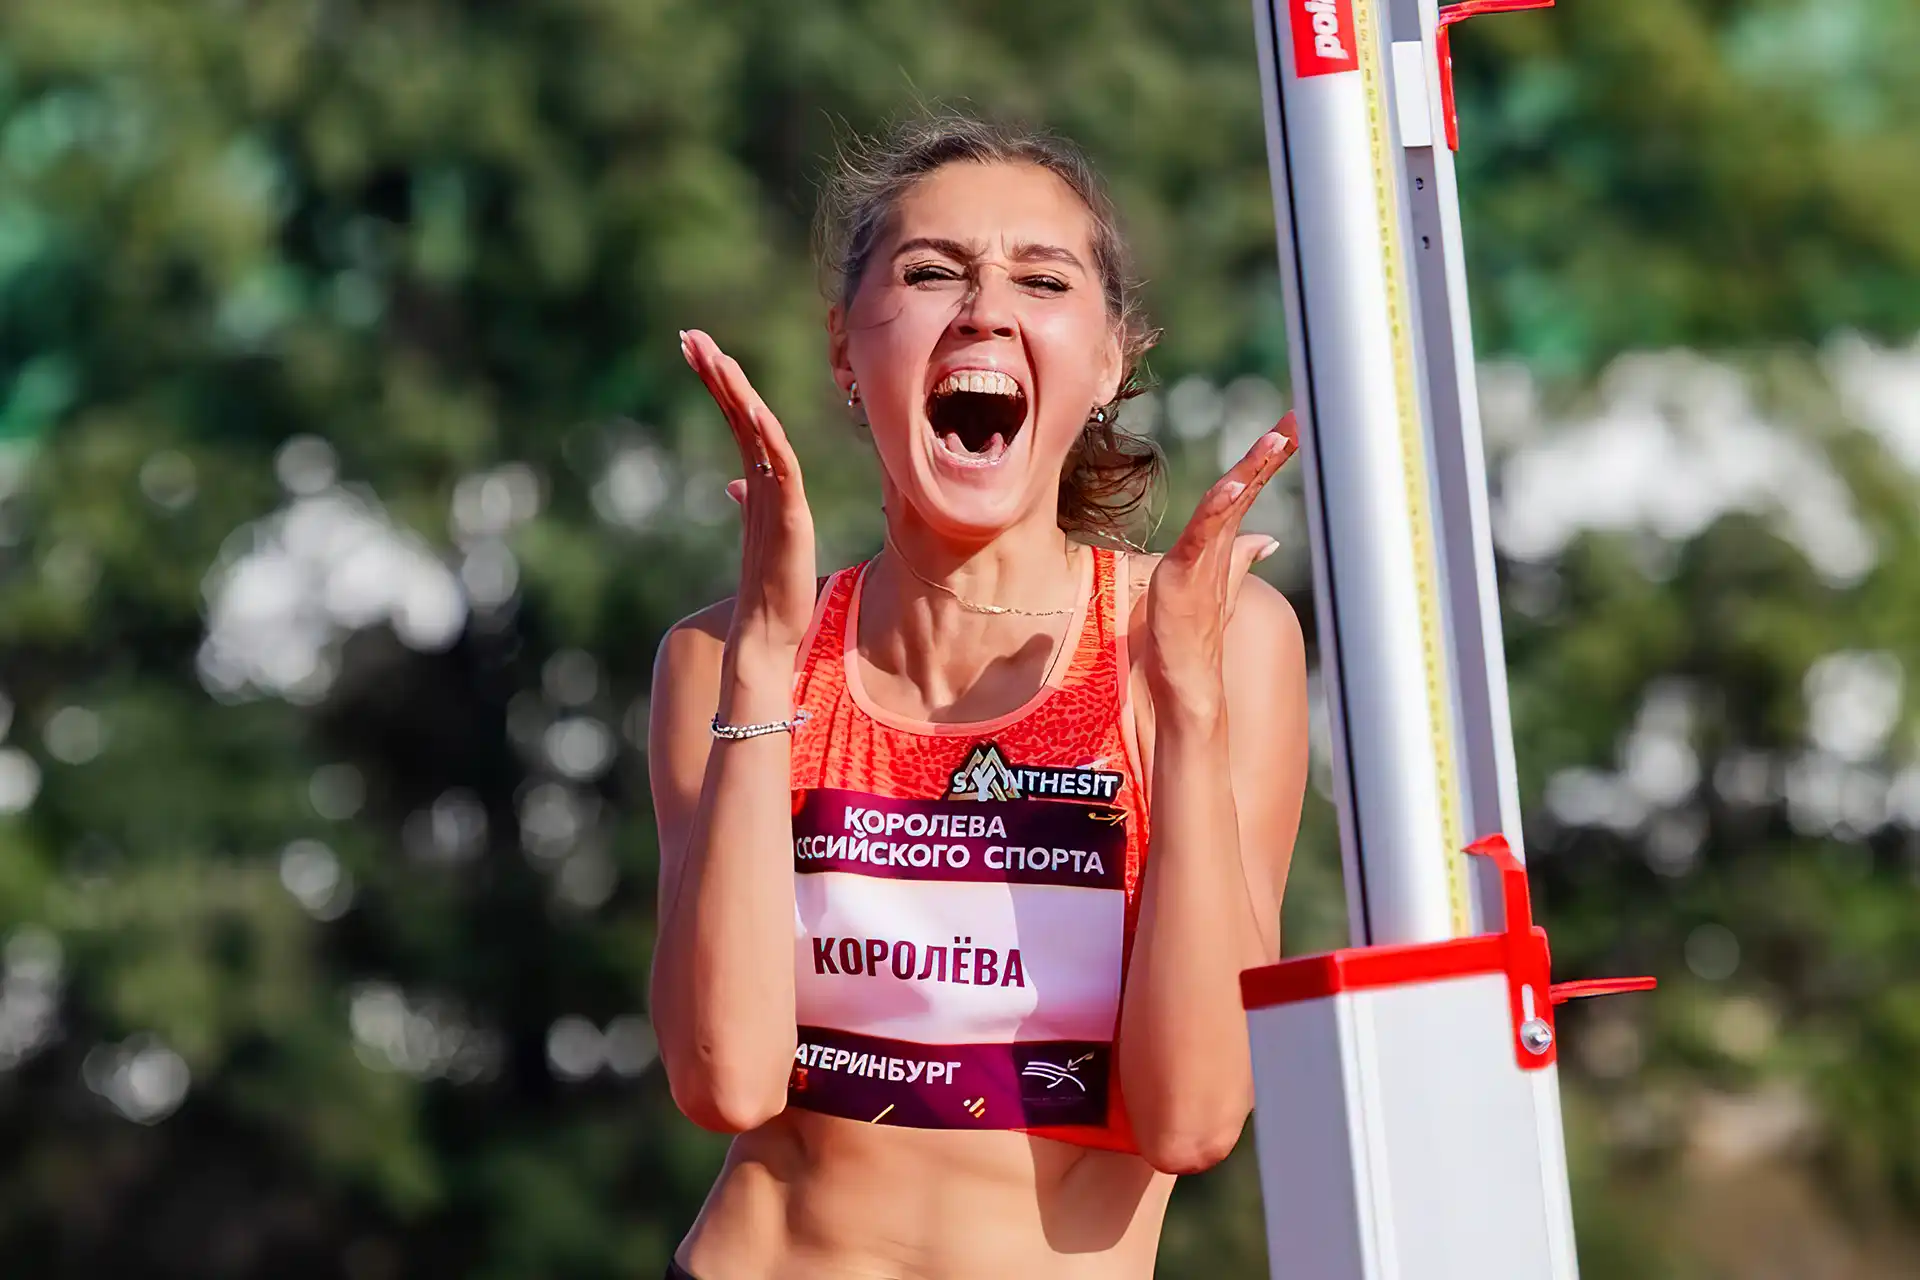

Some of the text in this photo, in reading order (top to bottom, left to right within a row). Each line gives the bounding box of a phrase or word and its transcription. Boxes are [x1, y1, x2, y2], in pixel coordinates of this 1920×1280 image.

[1304, 0, 1349, 60] pol
[952, 766, 1119, 802] SYNTHESIT
[844, 806, 1007, 839] КОРОЛЕВА
[984, 845, 1105, 875] СПОРТА
[812, 936, 1026, 988] КОРОЛЁВА
[795, 1043, 961, 1085] АТЕРИНБУРГ
